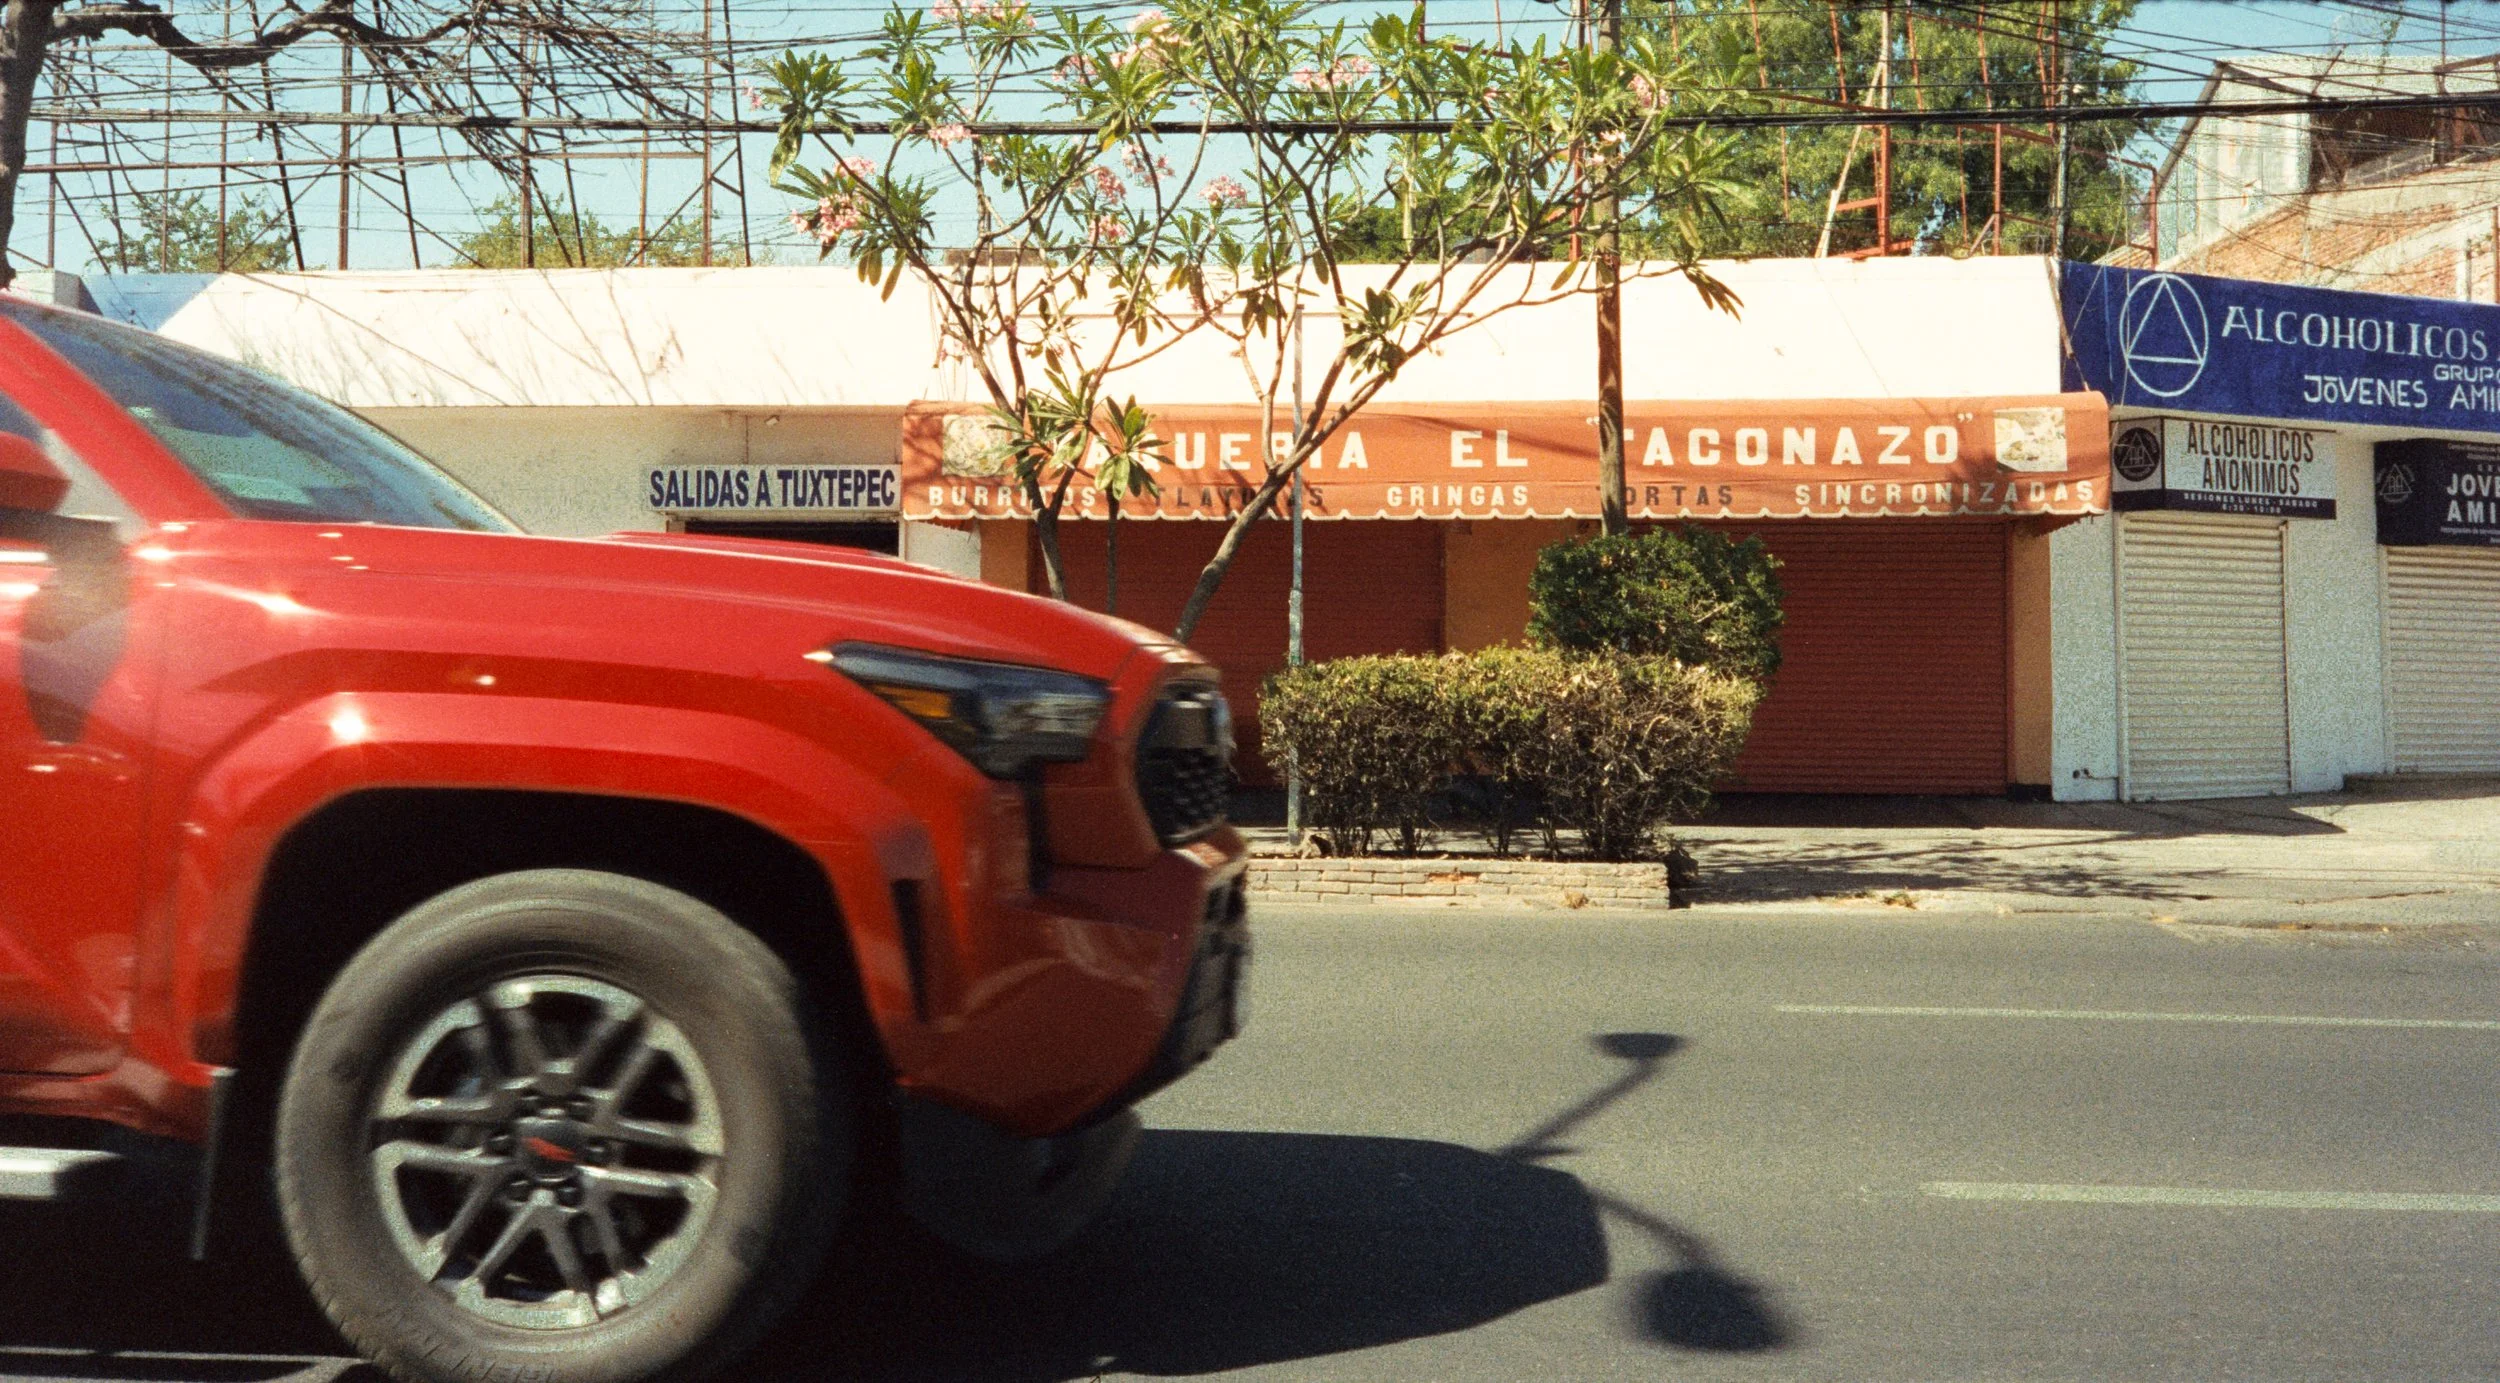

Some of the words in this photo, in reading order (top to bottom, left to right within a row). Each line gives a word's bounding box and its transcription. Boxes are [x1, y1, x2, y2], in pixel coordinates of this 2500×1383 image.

[2222, 306, 2488, 361] ALCOHOLICOS
[2449, 384, 2500, 412] AMI
[1451, 429, 1528, 467] EL
[2187, 422, 2314, 463] ALCOHOLICOS
[650, 470, 749, 508] SALIDAS
[755, 470, 771, 507] A
[777, 470, 895, 508] TUXTEPEC
[1596, 485, 1733, 506] ORTAS
[1795, 480, 2094, 506] SINCRONIZADAS
[2203, 457, 2300, 496] ANONIMOS
[1387, 485, 1528, 507] GRINGAS
